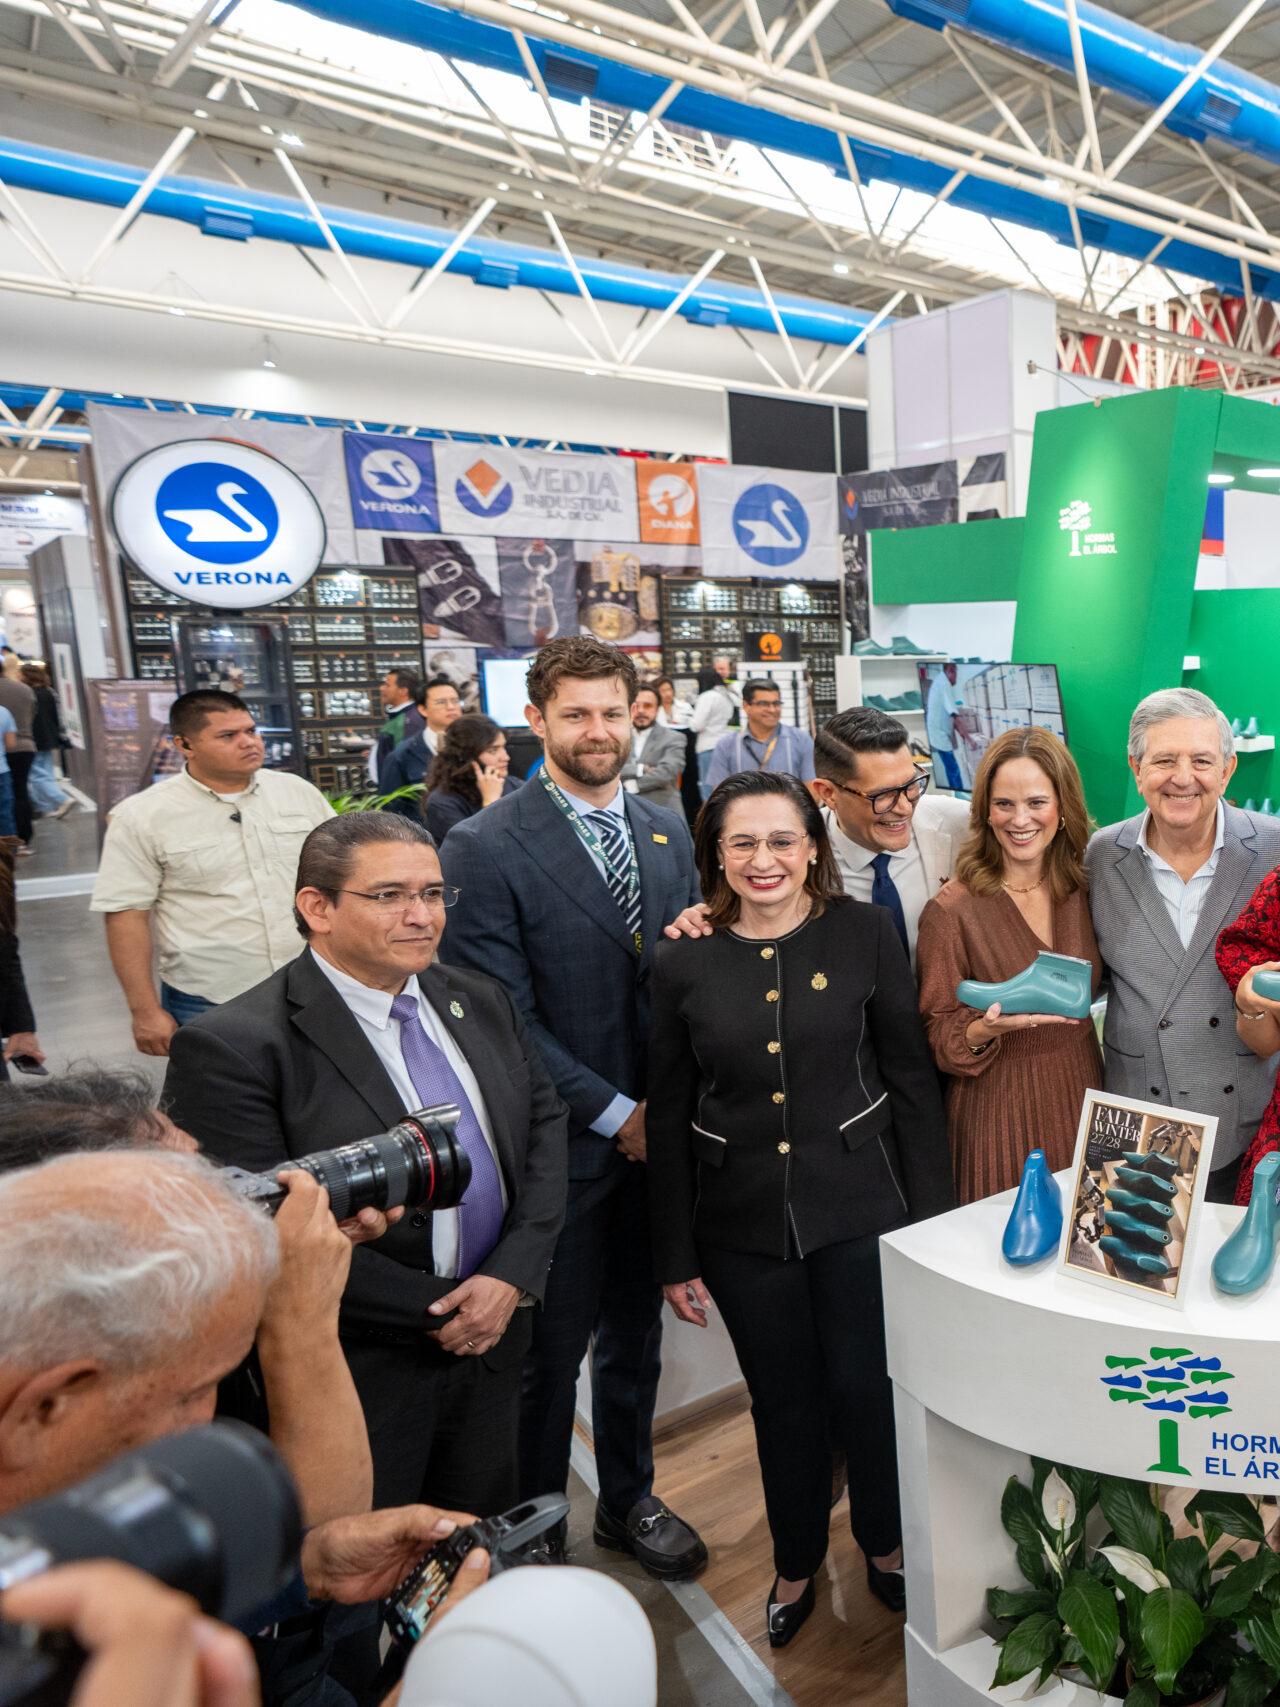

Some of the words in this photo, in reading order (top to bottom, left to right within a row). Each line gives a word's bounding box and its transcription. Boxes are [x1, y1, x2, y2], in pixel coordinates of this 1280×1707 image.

[519, 465, 619, 497] VEDIA
[359, 499, 432, 515] VERONA
[523, 494, 624, 513] INDUSTRIAL
[174, 572, 292, 585] VERONA
[1095, 1105, 1135, 1129] FALL
[1090, 1132, 1121, 1149] 27/28
[1094, 1120, 1140, 1142] WINTER
[1205, 1456, 1236, 1476] EL
